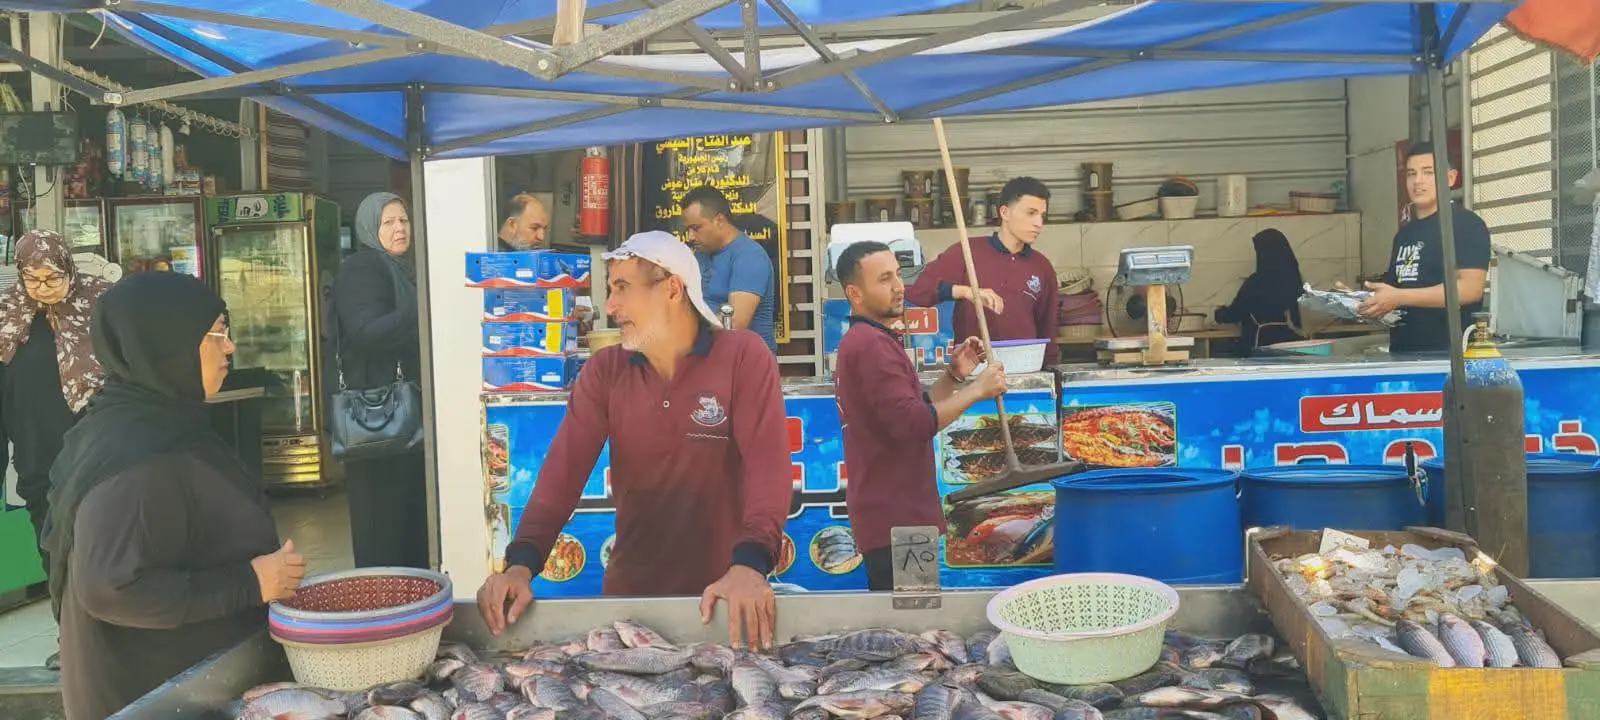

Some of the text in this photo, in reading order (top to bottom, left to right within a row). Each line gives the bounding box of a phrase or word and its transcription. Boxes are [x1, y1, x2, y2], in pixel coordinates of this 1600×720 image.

[696, 135, 729, 151] الفتاح
[731, 135, 752, 146] عبد
[1396, 244, 1421, 262] LIVE
[1319, 401, 1443, 426] سماك
